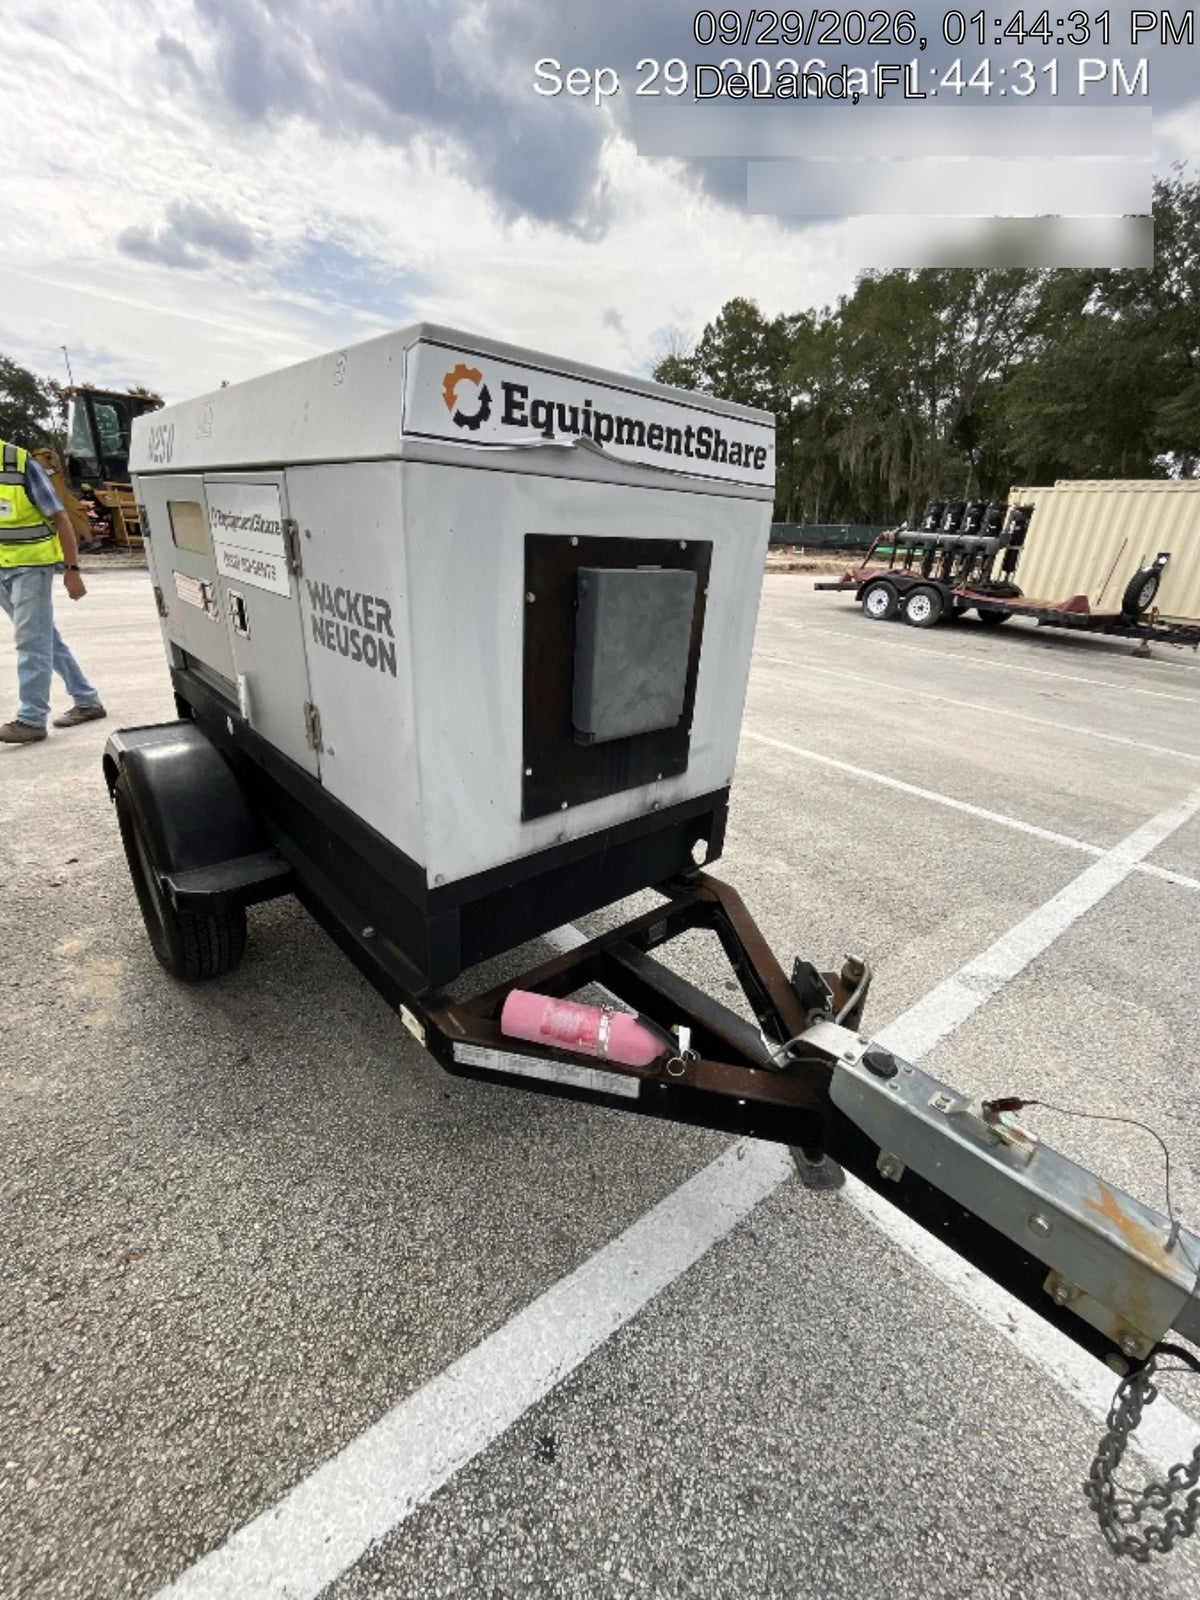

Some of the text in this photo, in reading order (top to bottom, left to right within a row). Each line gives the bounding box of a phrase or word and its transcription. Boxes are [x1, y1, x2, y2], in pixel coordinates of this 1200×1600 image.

[500, 380, 767, 470] EquipmentShare
[305, 579, 396, 639] WACKER
[310, 614, 398, 678] NEUSON
